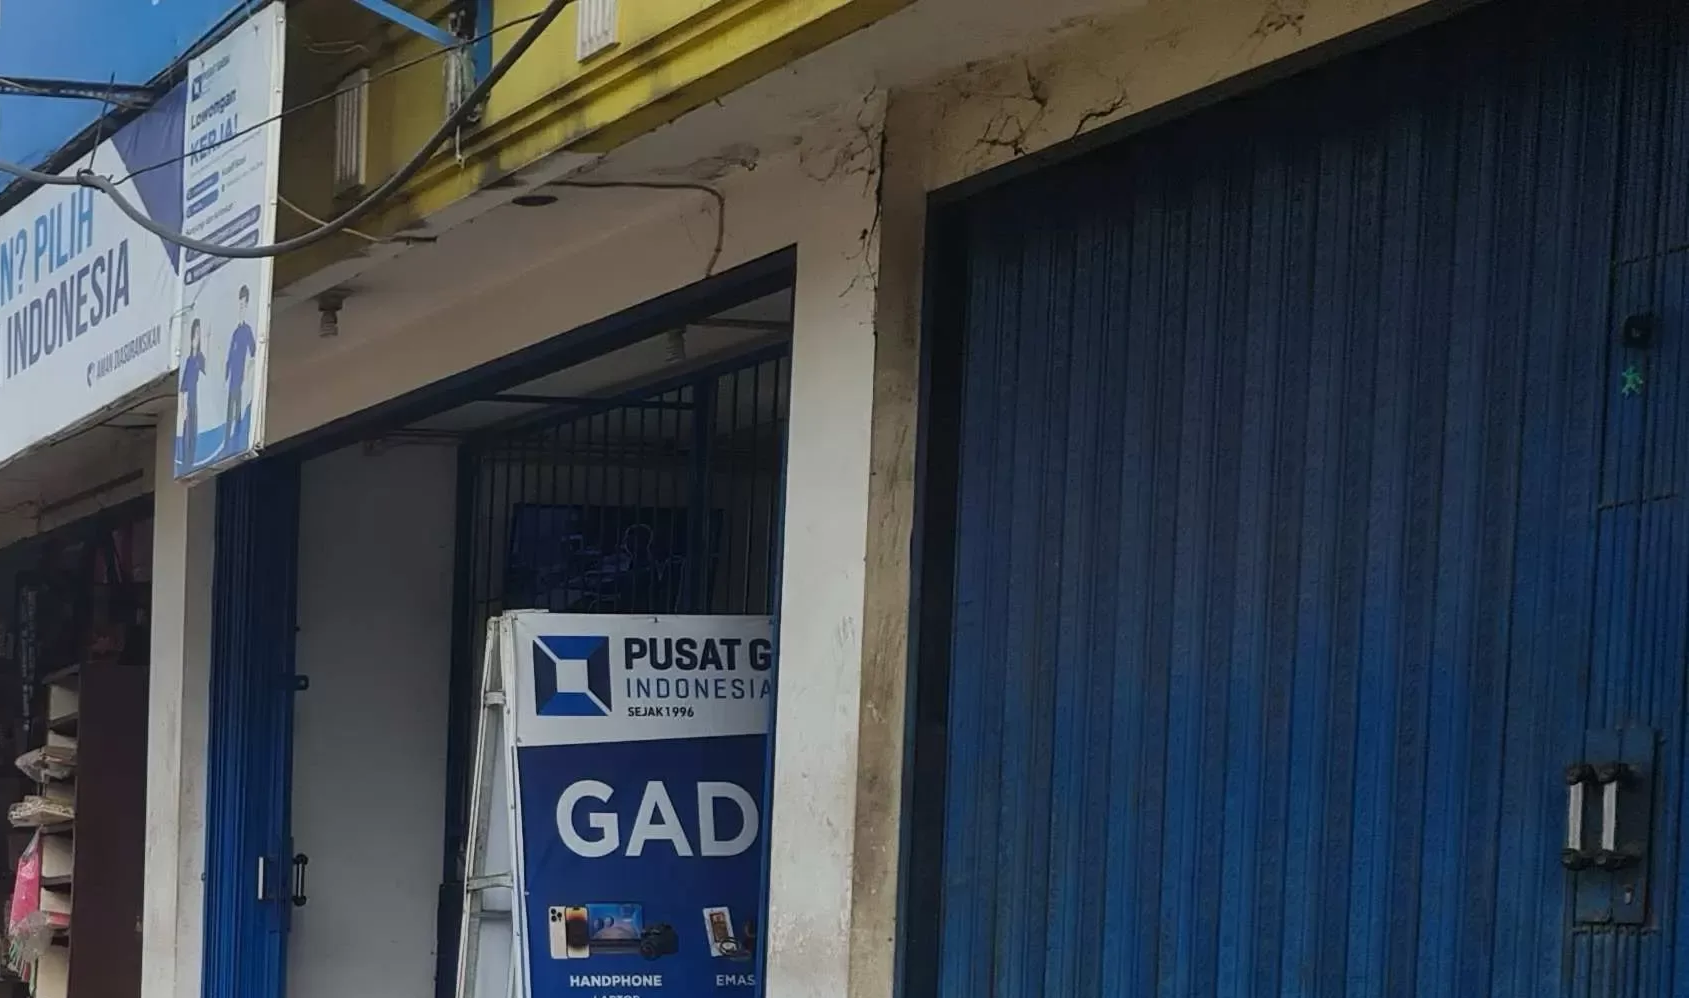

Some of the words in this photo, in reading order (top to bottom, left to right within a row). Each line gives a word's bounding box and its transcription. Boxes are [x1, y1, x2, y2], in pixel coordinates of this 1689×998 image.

[34, 184, 94, 284] PILIH
[6, 238, 129, 379] INDONESIA
[623, 637, 742, 671] PUSAT
[626, 677, 771, 700] INDONESIA
[627, 706, 664, 718] SEJAK
[665, 706, 695, 718] 1996
[555, 779, 760, 858] GAD
[569, 974, 664, 988] HANDPHONE
[716, 973, 757, 987] EMAS
